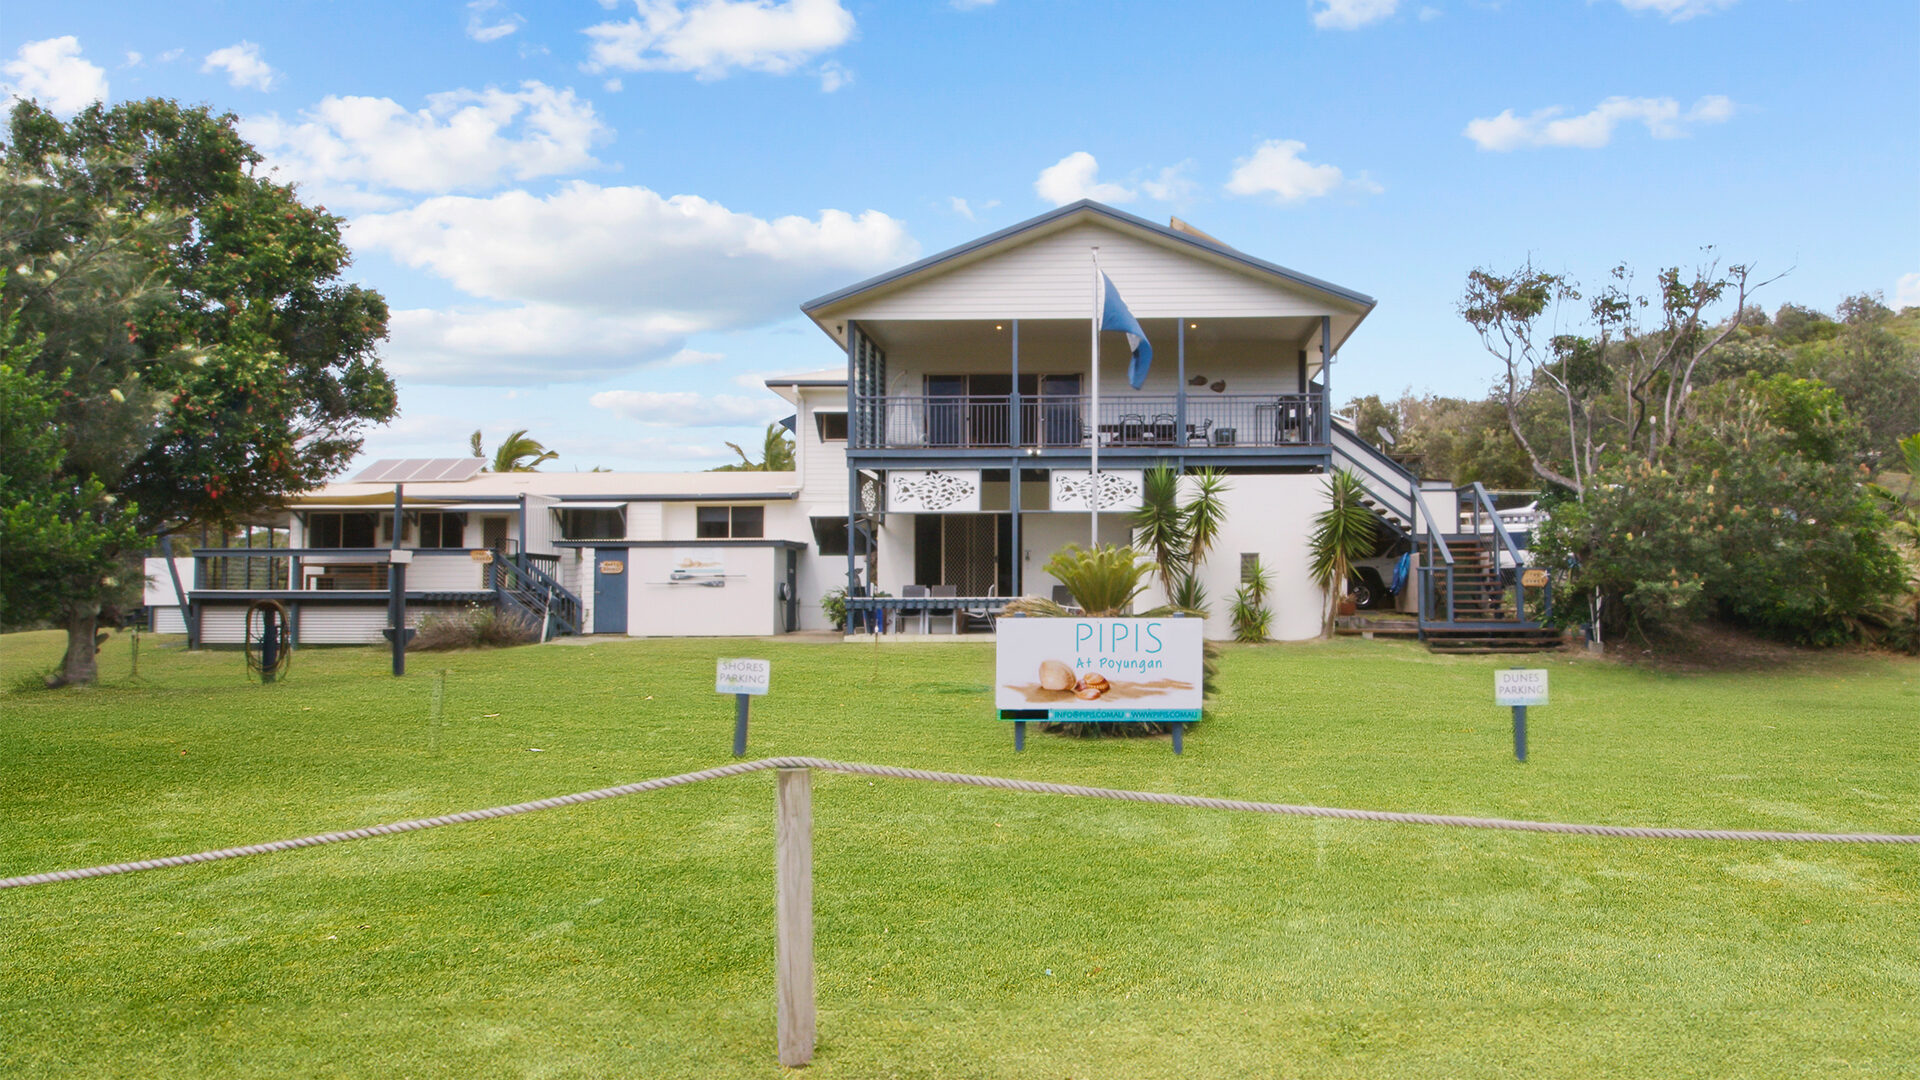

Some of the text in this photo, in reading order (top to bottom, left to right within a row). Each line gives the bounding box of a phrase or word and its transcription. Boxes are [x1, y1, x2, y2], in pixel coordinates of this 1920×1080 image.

[1076, 623, 1163, 653] PIPIS
[721, 662, 764, 672] SHORES
[1076, 657, 1163, 674] At Poyungan
[720, 672, 766, 684] PARKING
[1503, 673, 1540, 683] DUNES
[1499, 685, 1544, 695] PARKING
